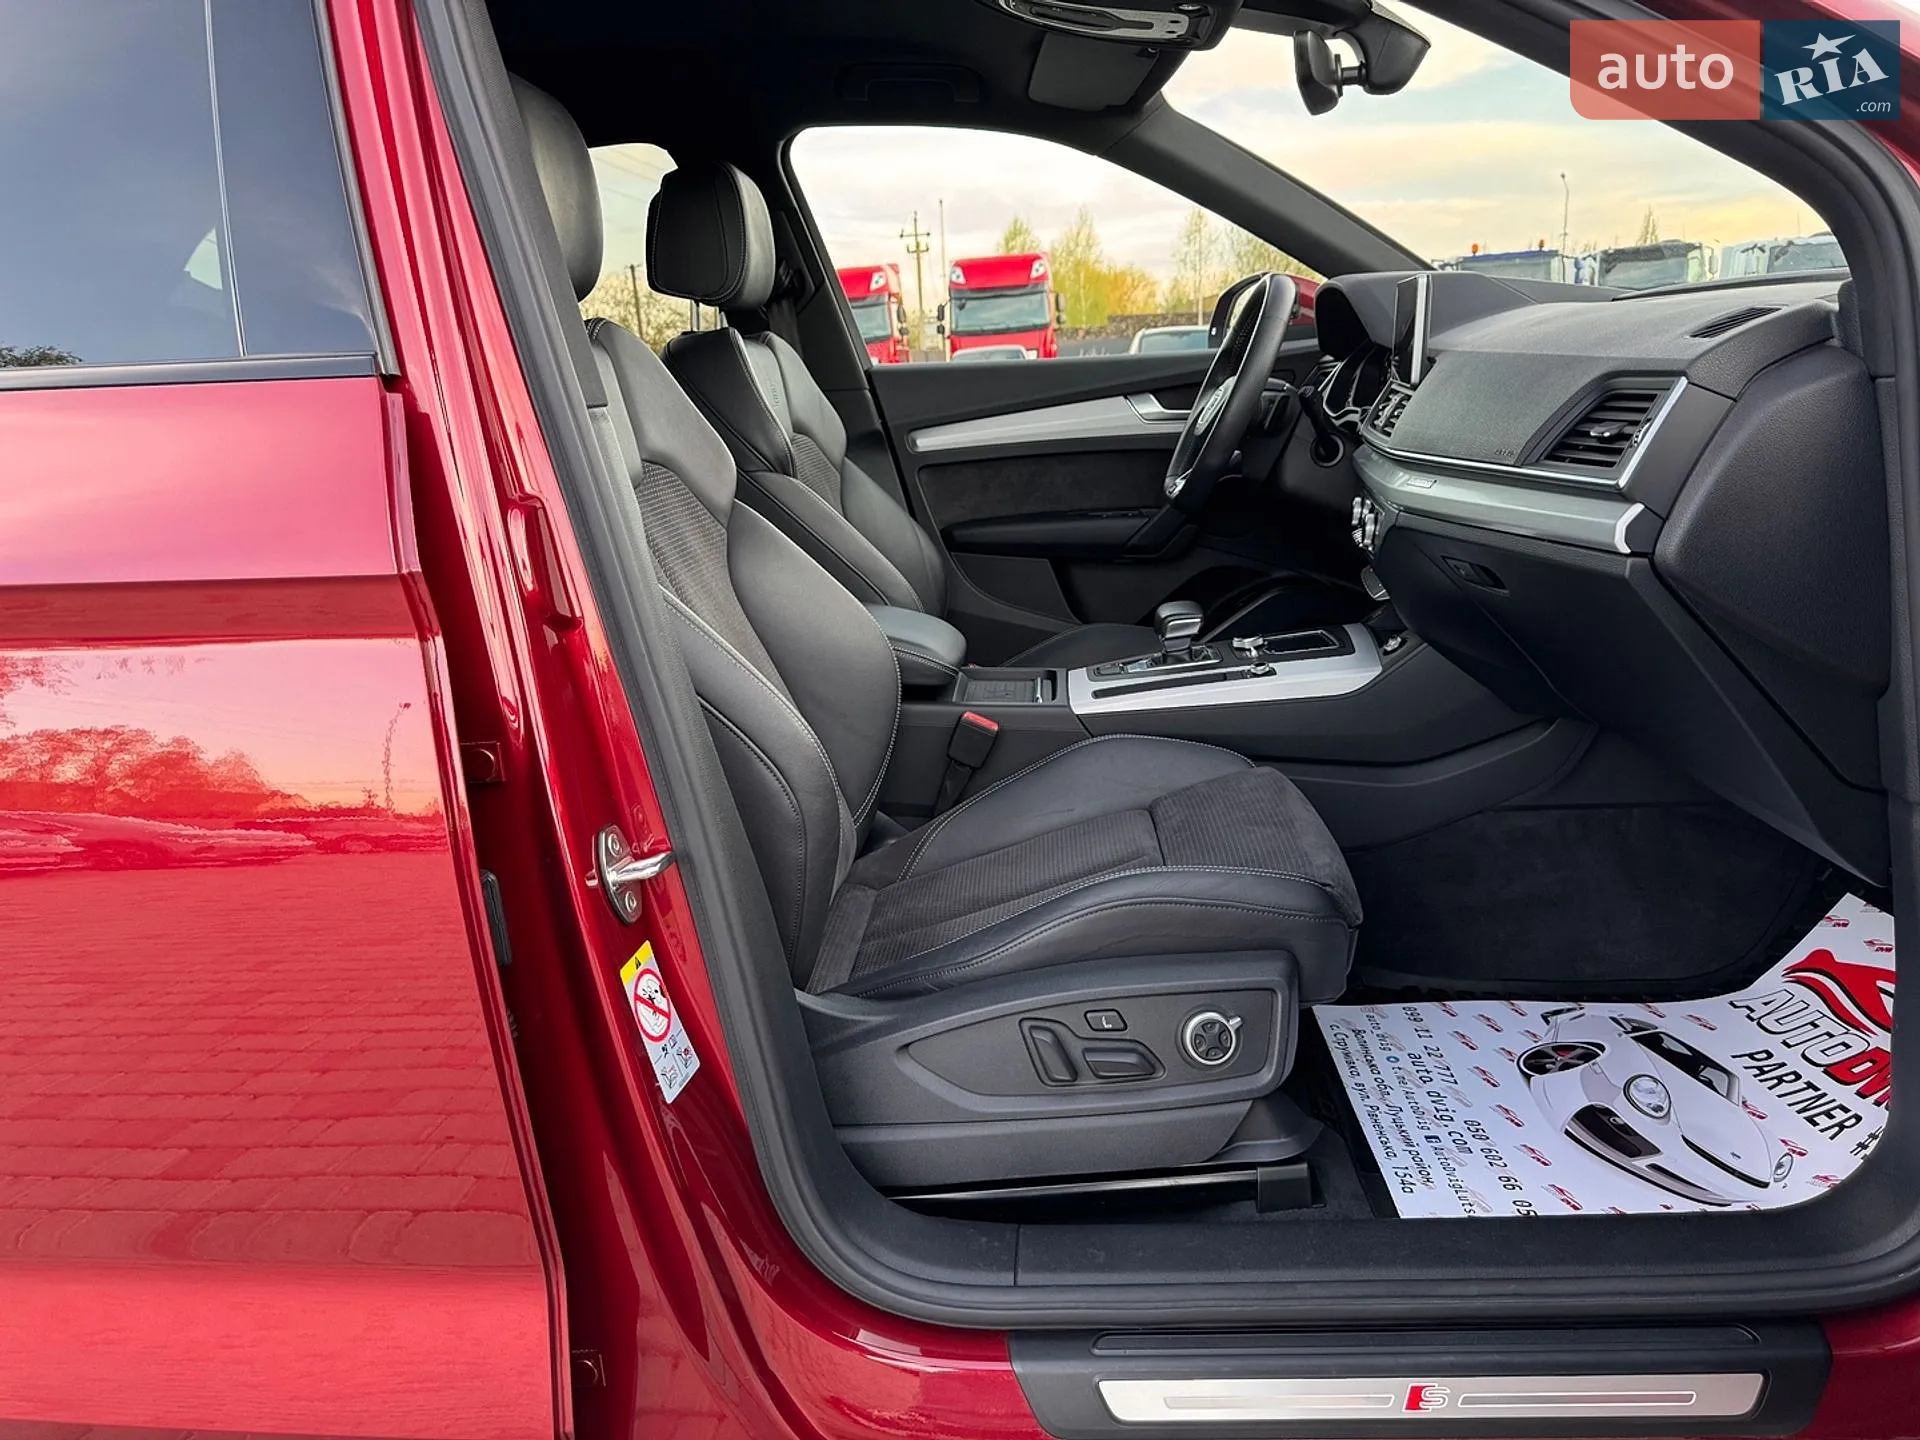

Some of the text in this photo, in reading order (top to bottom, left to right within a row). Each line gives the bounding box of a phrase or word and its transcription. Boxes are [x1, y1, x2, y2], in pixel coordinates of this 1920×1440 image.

[1402, 1006, 1423, 1023] 099
[1414, 1027, 1433, 1039] 11
[1423, 1045, 1444, 1058] 22
[1433, 1065, 1458, 1085] 777
[1407, 1053, 1473, 1155] auto dvig.com
[1730, 1049, 1863, 1141] PARTNER
[1463, 1119, 1490, 1141] 050
[1480, 1147, 1508, 1168] 602
[1430, 1145, 1476, 1217] AutoDvigLuts
[1498, 1175, 1523, 1191] 66
[1416, 1384, 1451, 1410] S
